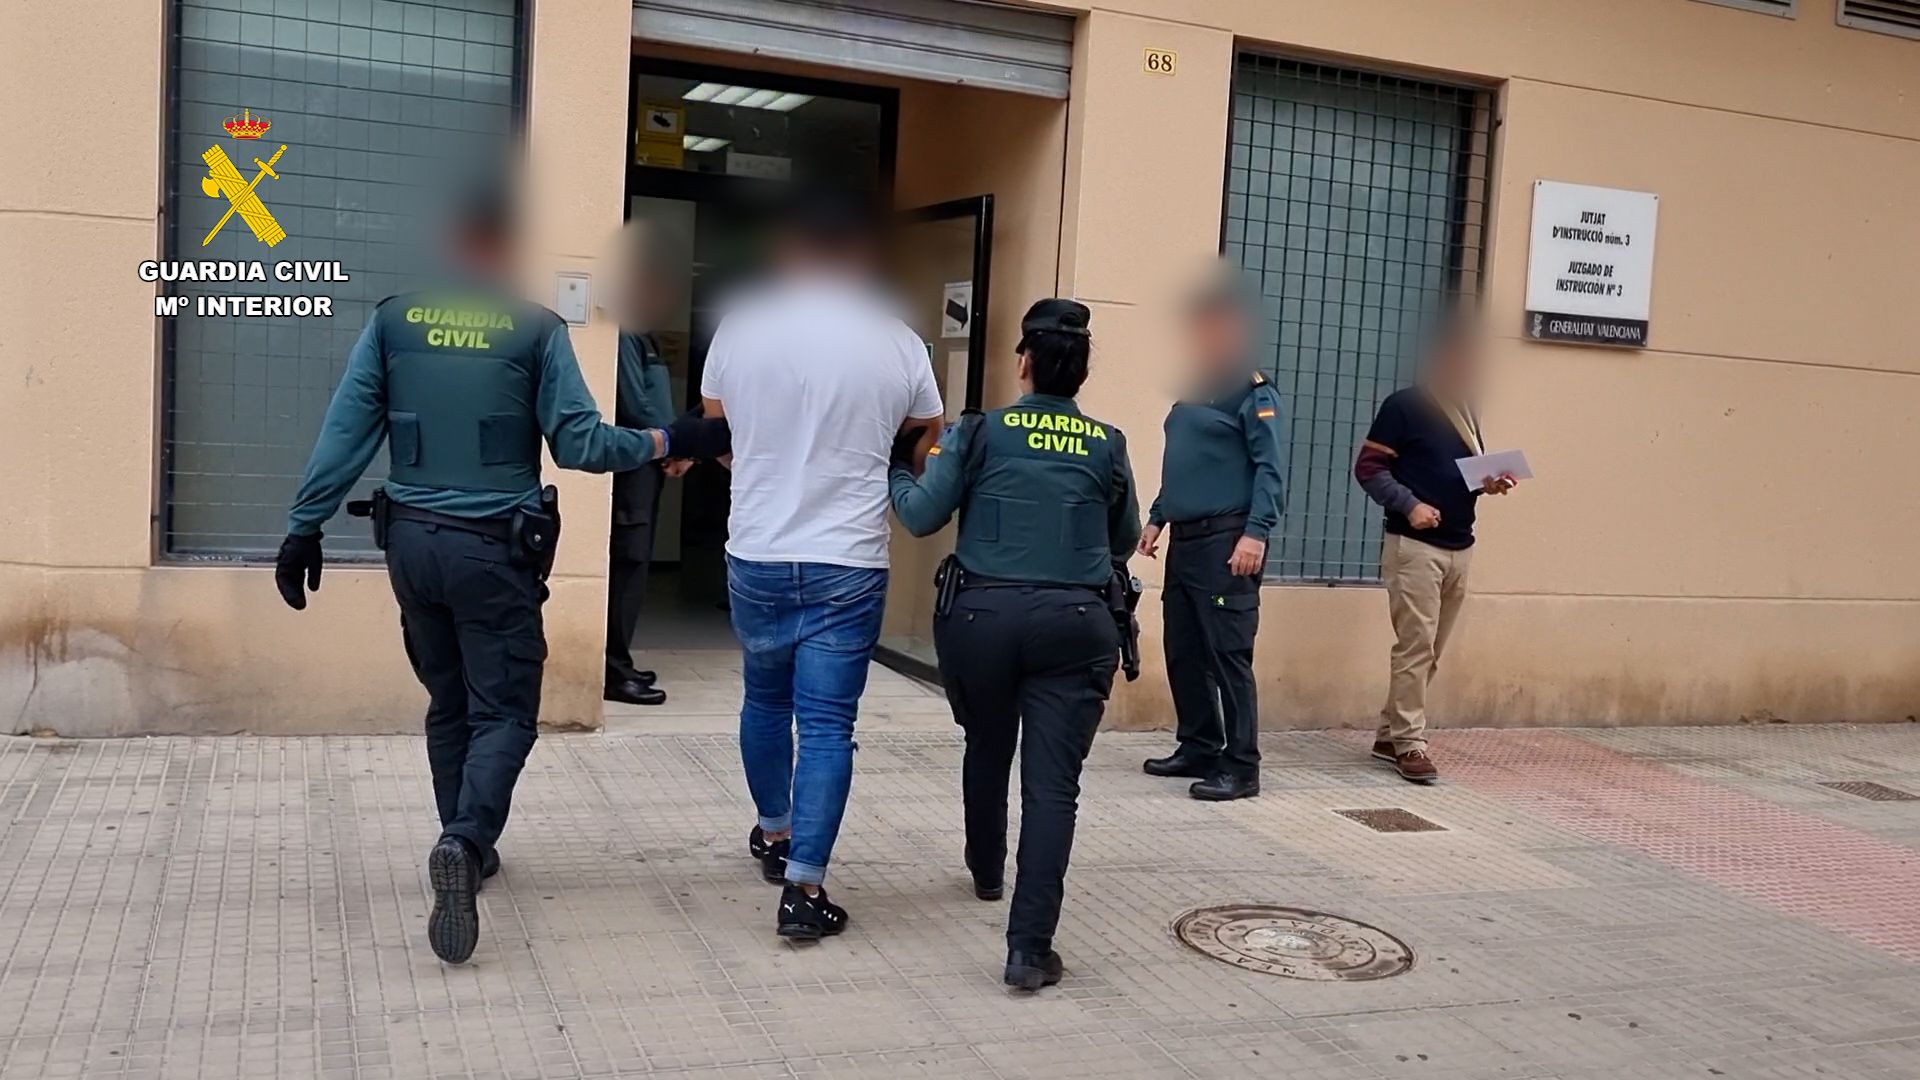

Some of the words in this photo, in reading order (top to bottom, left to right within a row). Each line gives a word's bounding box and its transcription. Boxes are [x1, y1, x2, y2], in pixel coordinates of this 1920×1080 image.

[1148, 53, 1172, 72] 68
[1580, 211, 1606, 225] JUTJAT
[1552, 225, 1604, 243] D'INSTRUCCIÓ
[1604, 232, 1623, 245] núm.
[1625, 234, 1631, 246] 3
[1568, 261, 1602, 276] JUZGADO
[1603, 265, 1614, 277] DE
[1556, 278, 1605, 295] INSTRUCCIÓN
[1617, 285, 1623, 296] 3
[406, 307, 514, 330] GUARDIA
[427, 328, 490, 349] CIVIL
[1549, 320, 1595, 336] GENERALITAT
[1597, 324, 1641, 340] VALENCIANA
[1003, 413, 1107, 440] GUARDIA
[1028, 432, 1089, 456] CIVIL
